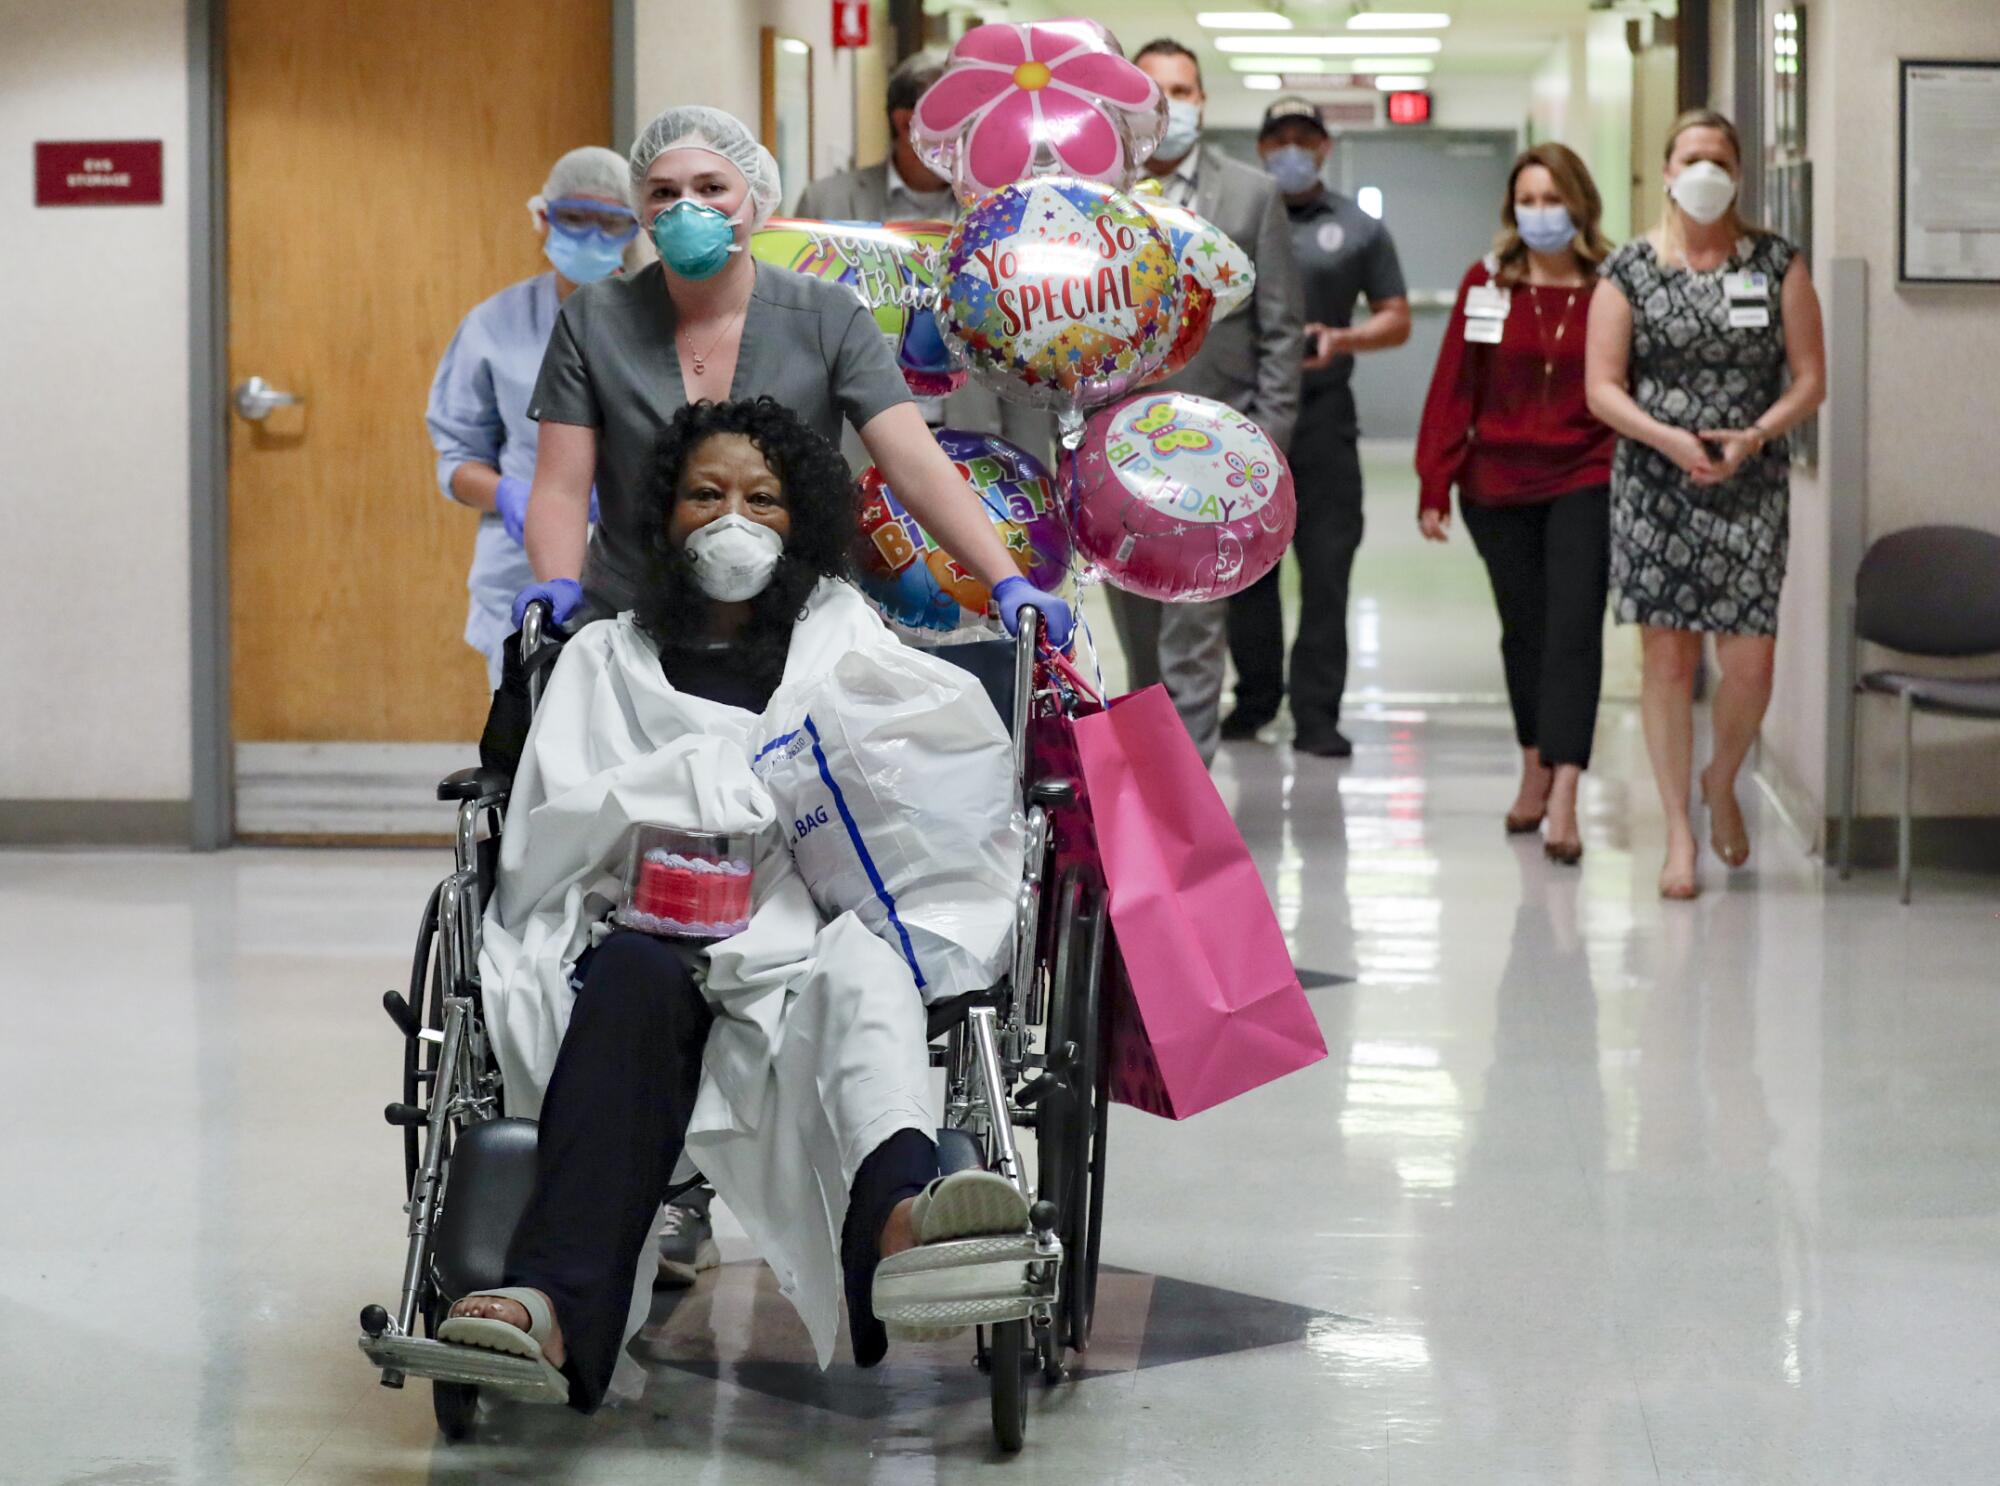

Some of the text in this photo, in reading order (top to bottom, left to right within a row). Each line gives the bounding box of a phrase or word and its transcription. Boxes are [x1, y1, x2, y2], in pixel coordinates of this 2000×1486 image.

[1095, 214, 1135, 260] So
[997, 264, 1140, 338] SPECIAL
[1106, 441, 1237, 523] BIRTHDAY
[794, 804, 829, 839] BAG
